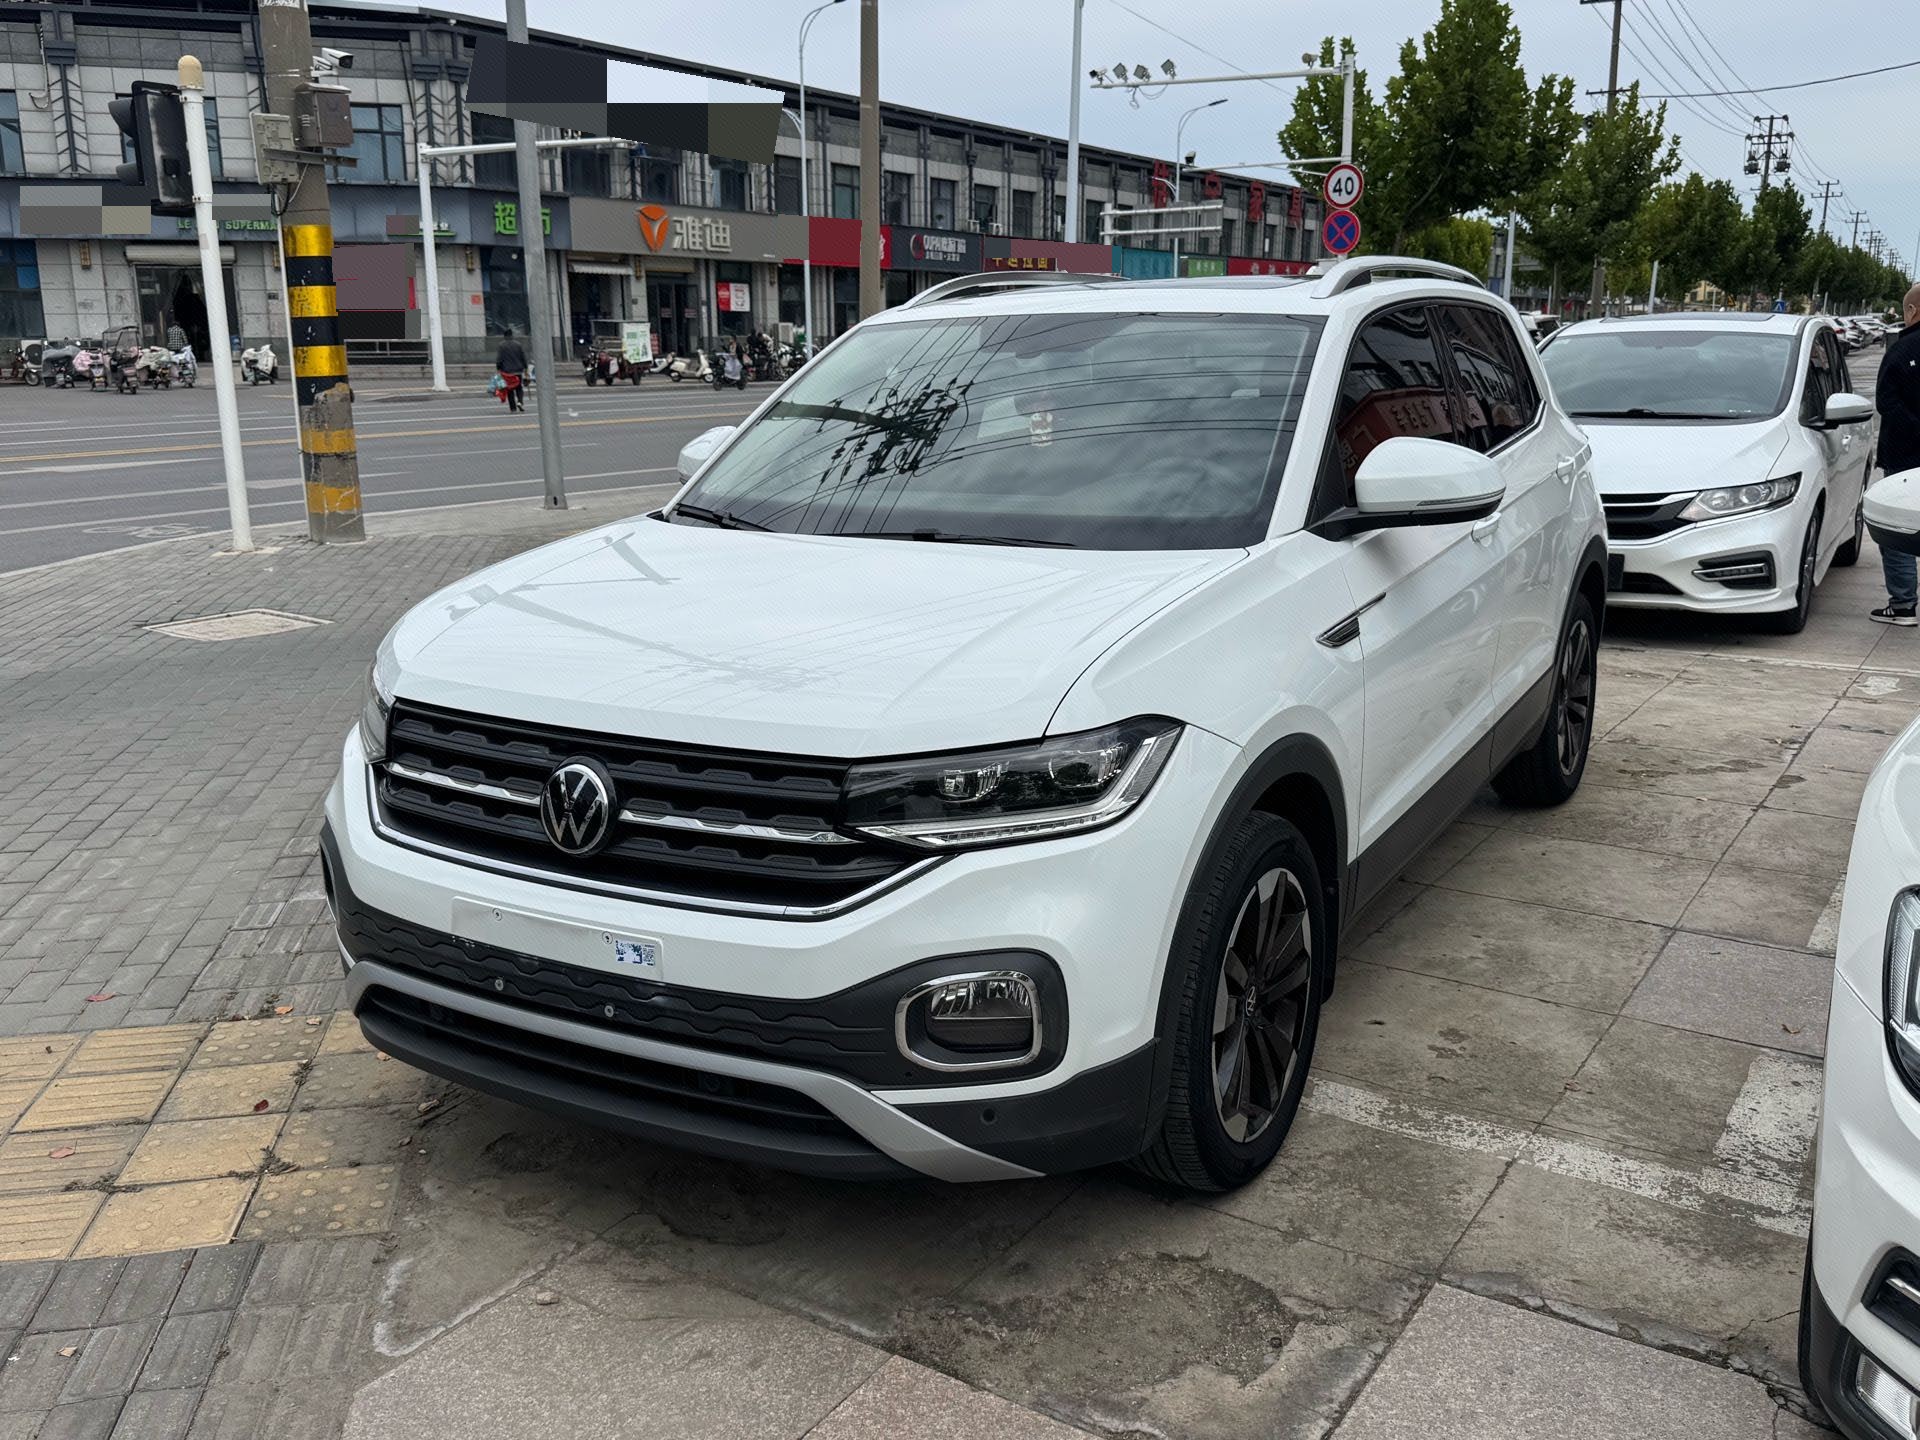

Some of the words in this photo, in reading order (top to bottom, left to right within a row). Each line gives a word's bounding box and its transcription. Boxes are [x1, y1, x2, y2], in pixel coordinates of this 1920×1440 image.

[1332, 176, 1354, 197] 40
[225, 220, 278, 231] SUPERMA
[672, 216, 733, 252] 雅迪
